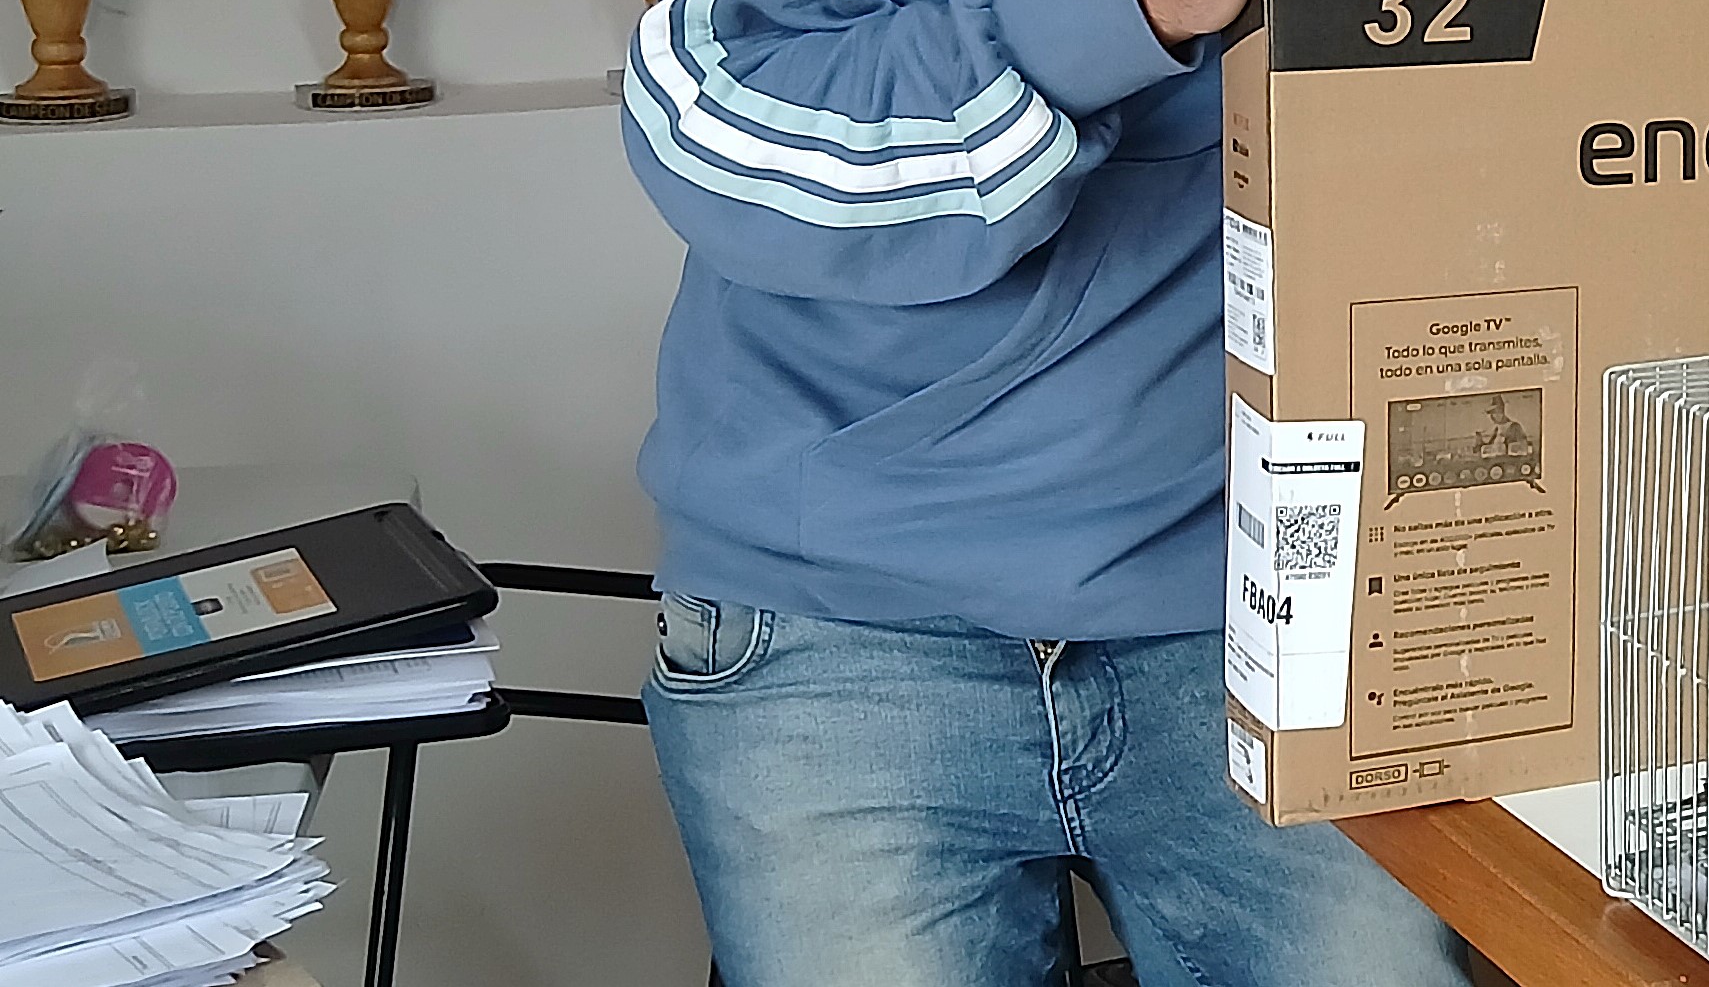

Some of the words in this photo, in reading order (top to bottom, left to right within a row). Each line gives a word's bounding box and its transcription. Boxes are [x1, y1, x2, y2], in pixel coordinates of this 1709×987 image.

[1429, 320, 1481, 337] Google
[1385, 345, 1419, 359] Todo
[1422, 344, 1435, 357] lo
[1438, 343, 1464, 358] que
[1380, 364, 1412, 379] todo
[1416, 362, 1433, 375] en
[1436, 362, 1461, 374] una
[1465, 357, 1492, 370] sola
[1242, 574, 1293, 624] FBA04
[1355, 769, 1401, 785] DORSO
